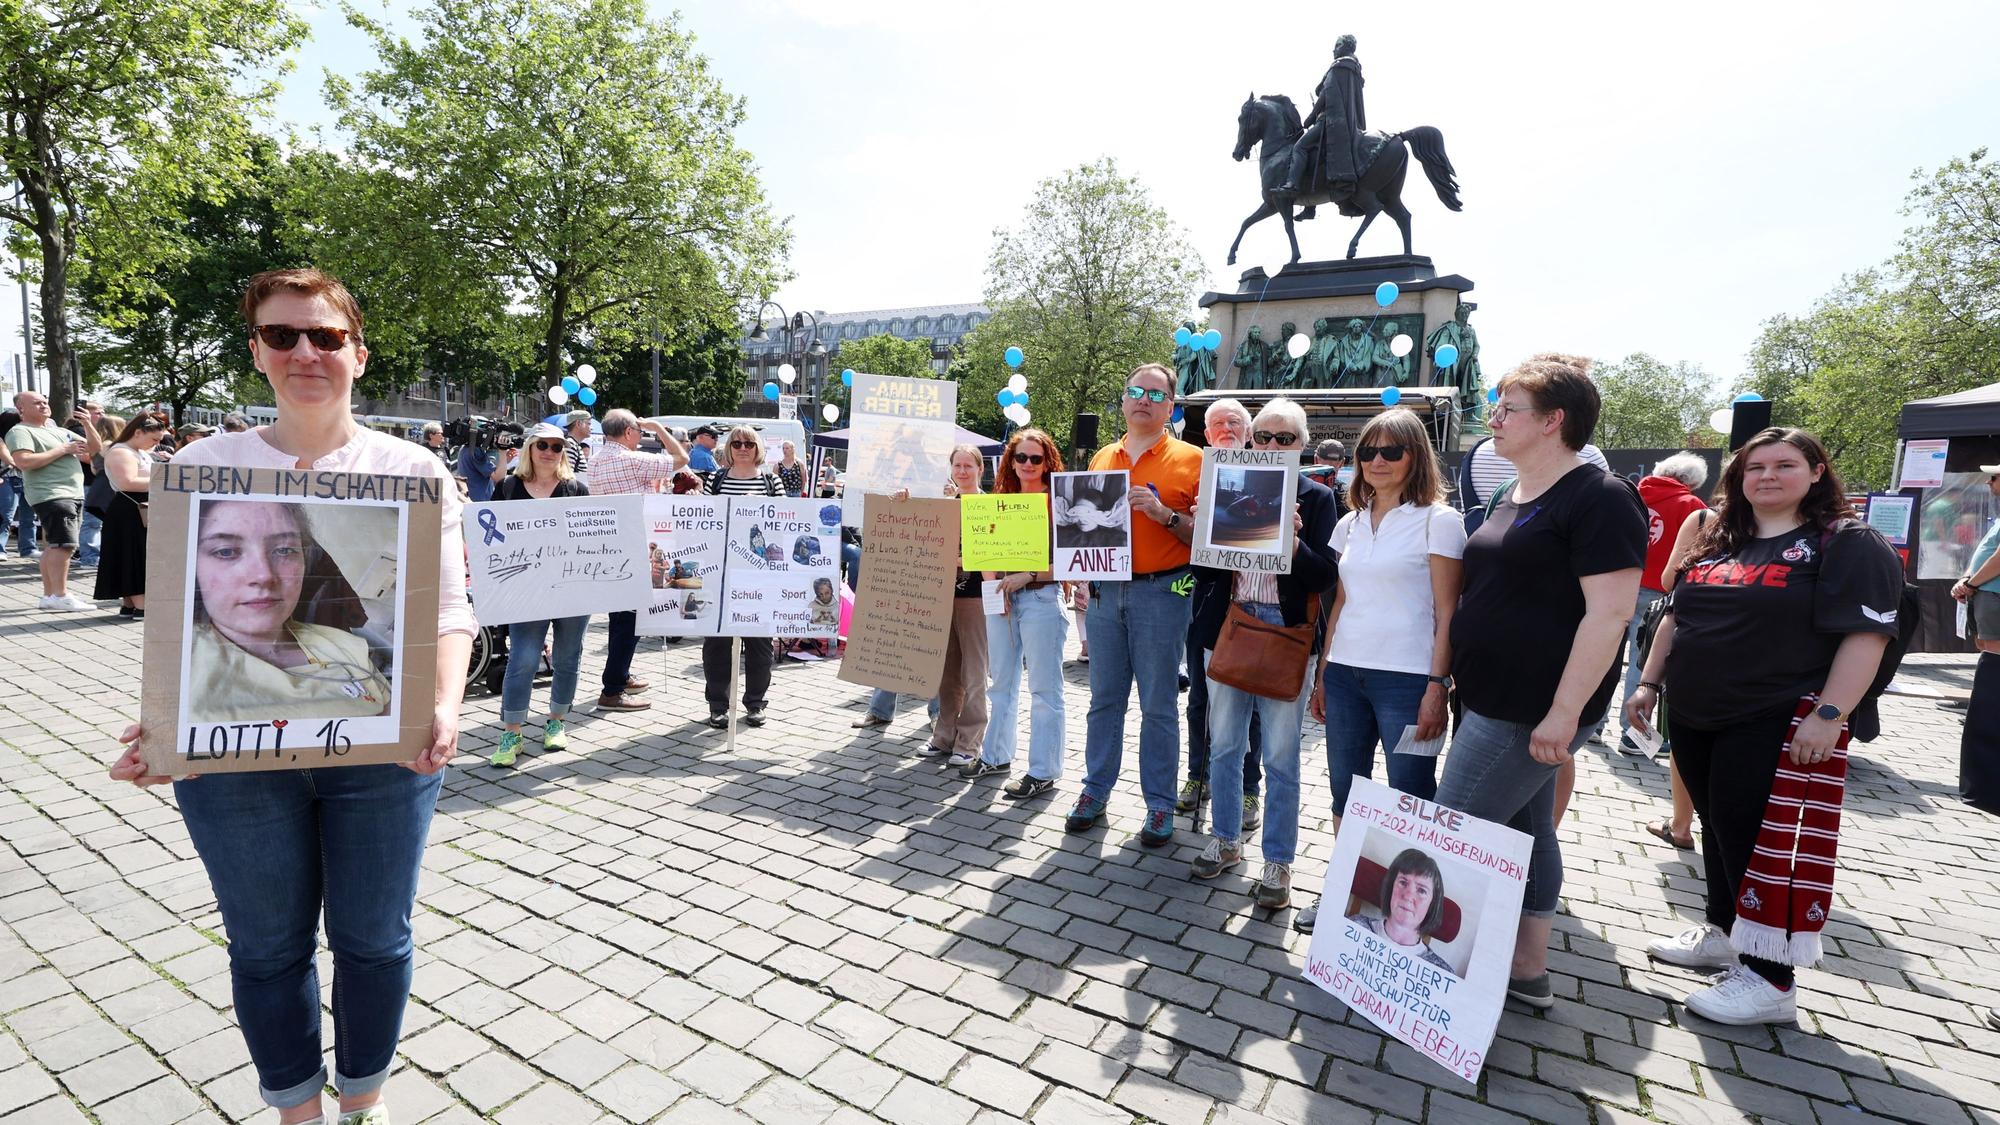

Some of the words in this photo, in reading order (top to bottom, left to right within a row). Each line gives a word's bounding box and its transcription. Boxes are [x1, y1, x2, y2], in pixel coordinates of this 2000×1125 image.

[1212, 449, 1228, 463] 18
[1231, 450, 1286, 465] MONATE
[163, 464, 252, 495] LEBEN
[275, 471, 308, 498] IM
[314, 471, 443, 504] SCHATTEN
[565, 508, 616, 519] Schmerzen
[672, 504, 714, 518] Leonie
[759, 504, 776, 519] 16
[777, 511, 796, 520] mit
[506, 519, 525, 531] ME
[533, 518, 557, 529] CFS
[654, 521, 672, 529] vor
[675, 520, 692, 530] ME
[764, 521, 781, 531] ME
[568, 528, 617, 539] Dunkelheit
[870, 525, 895, 539] durch
[899, 529, 910, 540] die
[914, 530, 945, 547] Impfung
[546, 545, 569, 557] Wir
[576, 544, 622, 556] brauchen
[662, 542, 709, 561] Handball
[728, 539, 766, 571] Rollstuhl
[879, 542, 898, 554] Luna
[903, 545, 913, 556] 17
[916, 546, 939, 559] Jahre
[769, 562, 789, 571] Bett
[810, 556, 832, 567] Sofa
[912, 560, 945, 573] Schmerzen
[1068, 548, 1117, 572] ANNE
[1119, 555, 1129, 572] 17
[1195, 549, 1212, 563] DER
[1252, 553, 1287, 572] ALLTAG
[561, 559, 633, 581] Hilfe!
[692, 564, 719, 578] Kanu
[1685, 562, 1793, 588] REWE
[731, 590, 763, 600] Schule
[781, 589, 807, 600] Sport
[648, 599, 680, 616] Musik
[732, 613, 760, 623] Musik
[772, 611, 811, 621] Freunde
[776, 623, 806, 634] treffen
[315, 719, 351, 758] 16
[1397, 795, 1464, 832] SILKE
[1349, 802, 1382, 823] SEIT
[1380, 812, 1414, 838] 2021
[1416, 823, 1524, 881] HAUSGEBUNDEN
[1344, 924, 1361, 944] ZU
[1363, 936, 1387, 958] 90%
[1388, 943, 1457, 995] ISOLIERT
[1355, 948, 1397, 984] HINTER
[1404, 977, 1431, 1000] DER
[1337, 952, 1452, 1031] SCHALLSCHUTZTÜR
[1308, 956, 1333, 984] WAS
[1332, 965, 1354, 991] IST
[1351, 984, 1399, 1026] DARAN
[1399, 1008, 1482, 1079] LEBEN?
